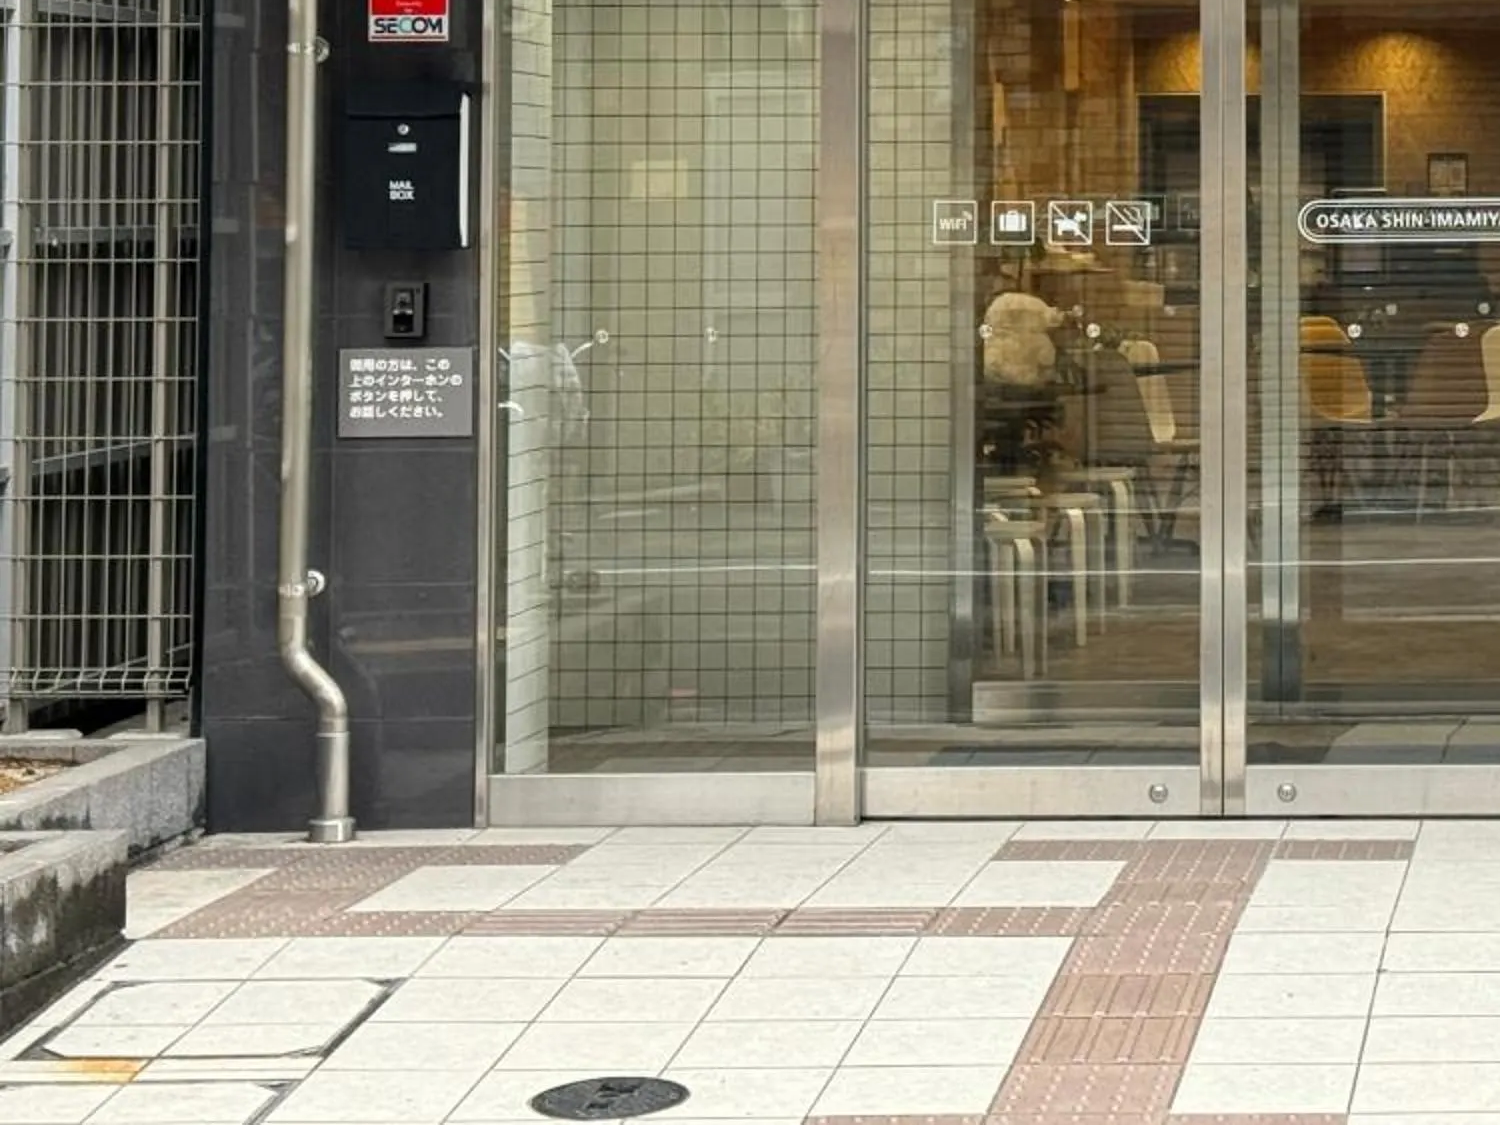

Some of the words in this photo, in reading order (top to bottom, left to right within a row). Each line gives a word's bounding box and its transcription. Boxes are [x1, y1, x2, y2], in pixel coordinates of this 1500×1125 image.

[374, 17, 443, 34] SECOM
[389, 180, 414, 190] MAIL
[389, 190, 415, 200] BOX
[1315, 213, 1376, 229] OSAKA
